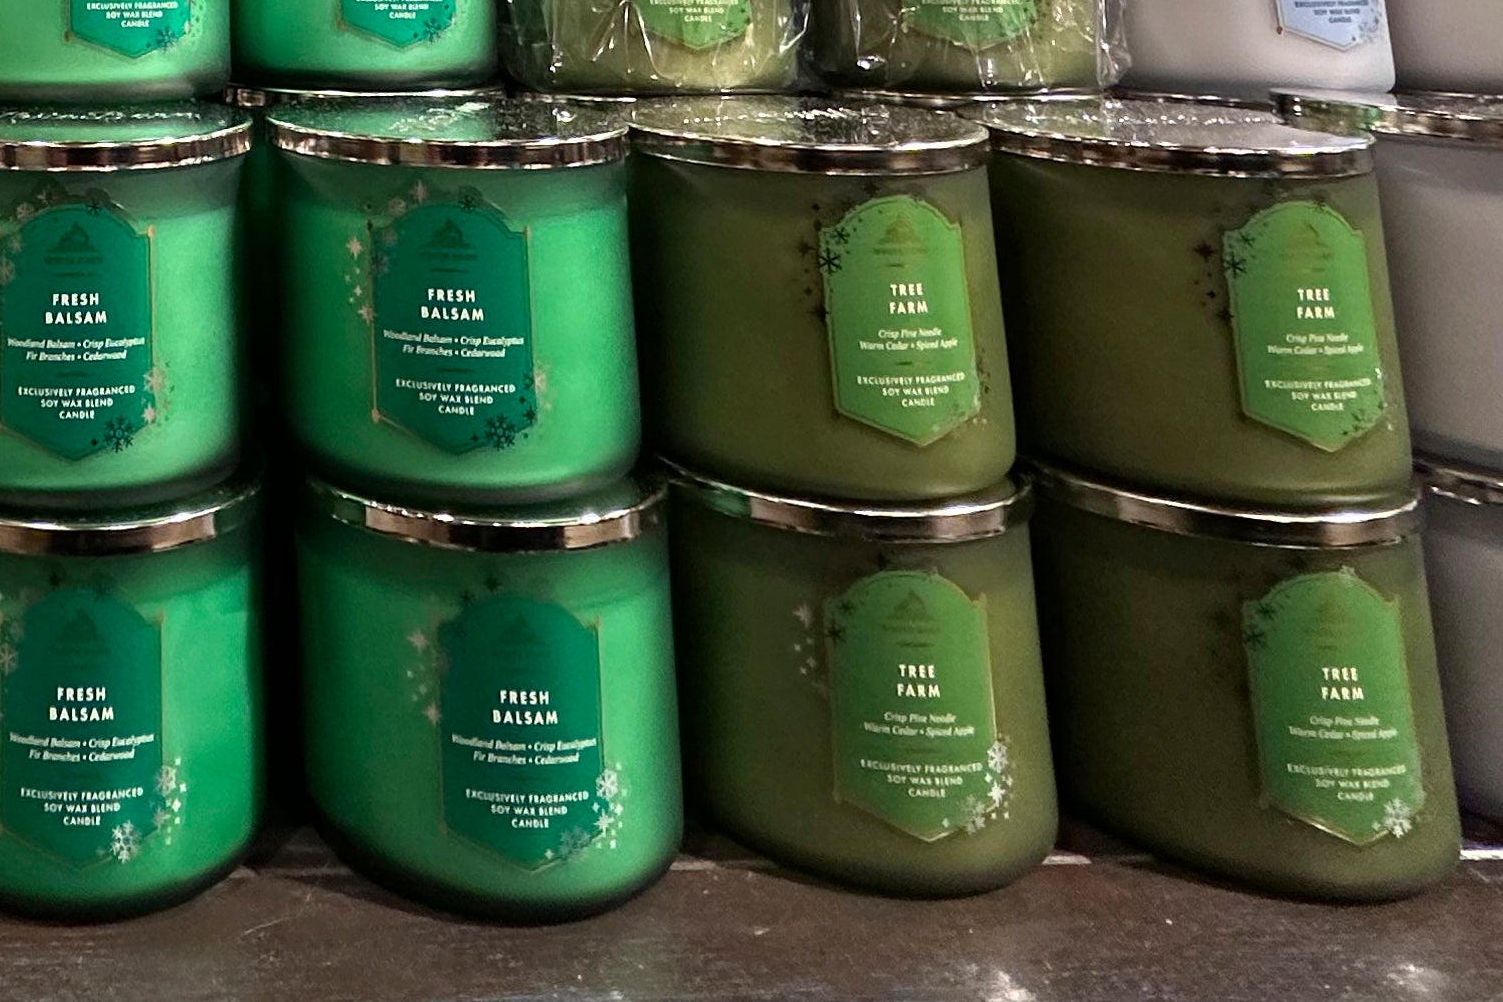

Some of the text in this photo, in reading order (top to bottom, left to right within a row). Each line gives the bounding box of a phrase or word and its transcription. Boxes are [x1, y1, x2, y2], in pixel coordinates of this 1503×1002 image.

[428, 289, 475, 302] FRESH
[890, 283, 923, 296] TREE
[1298, 288, 1329, 301] TREE
[52, 293, 99, 306] FRESH
[421, 306, 484, 320] BALSAM
[890, 302, 928, 314] FARM
[1297, 307, 1334, 319] FARM
[45, 311, 107, 324] BALSAM
[83, 339, 104, 349] Crisp
[396, 378, 516, 393] EXCLUSIVELY FRAGRANCED
[857, 373, 965, 385] EXCLUSIVELY FRAGRANCED
[18, 385, 136, 397] EXCLUSIVELY FRAGRANCED
[883, 386, 949, 396] SOY WAX BLEND
[41, 398, 113, 407] SOY WAX BLEND
[419, 392, 493, 405] SOY WAX BLEND
[902, 398, 934, 407] CANDLE
[59, 410, 95, 419] CANDLE
[438, 405, 474, 415] CANDLE
[899, 664, 935, 679] TREE
[1322, 667, 1358, 681] TREE
[57, 687, 106, 701] FRESH
[500, 690, 548, 704] FRESH
[897, 684, 940, 698] FARM
[1321, 687, 1364, 700] FARM
[49, 707, 114, 721] BALSAM
[493, 710, 558, 724] BALSAM
[21, 787, 143, 800] EXCLUSIVELY FRAGRANCED
[466, 789, 589, 803] EXCLUSIVELY FRAGRANCED
[908, 788, 946, 797] CANDLE
[44, 802, 120, 812] SOY WAX BLEND
[491, 805, 567, 815] SOY WAX BLEND
[63, 816, 101, 825] CANDLE
[512, 819, 549, 828] CANDLE
